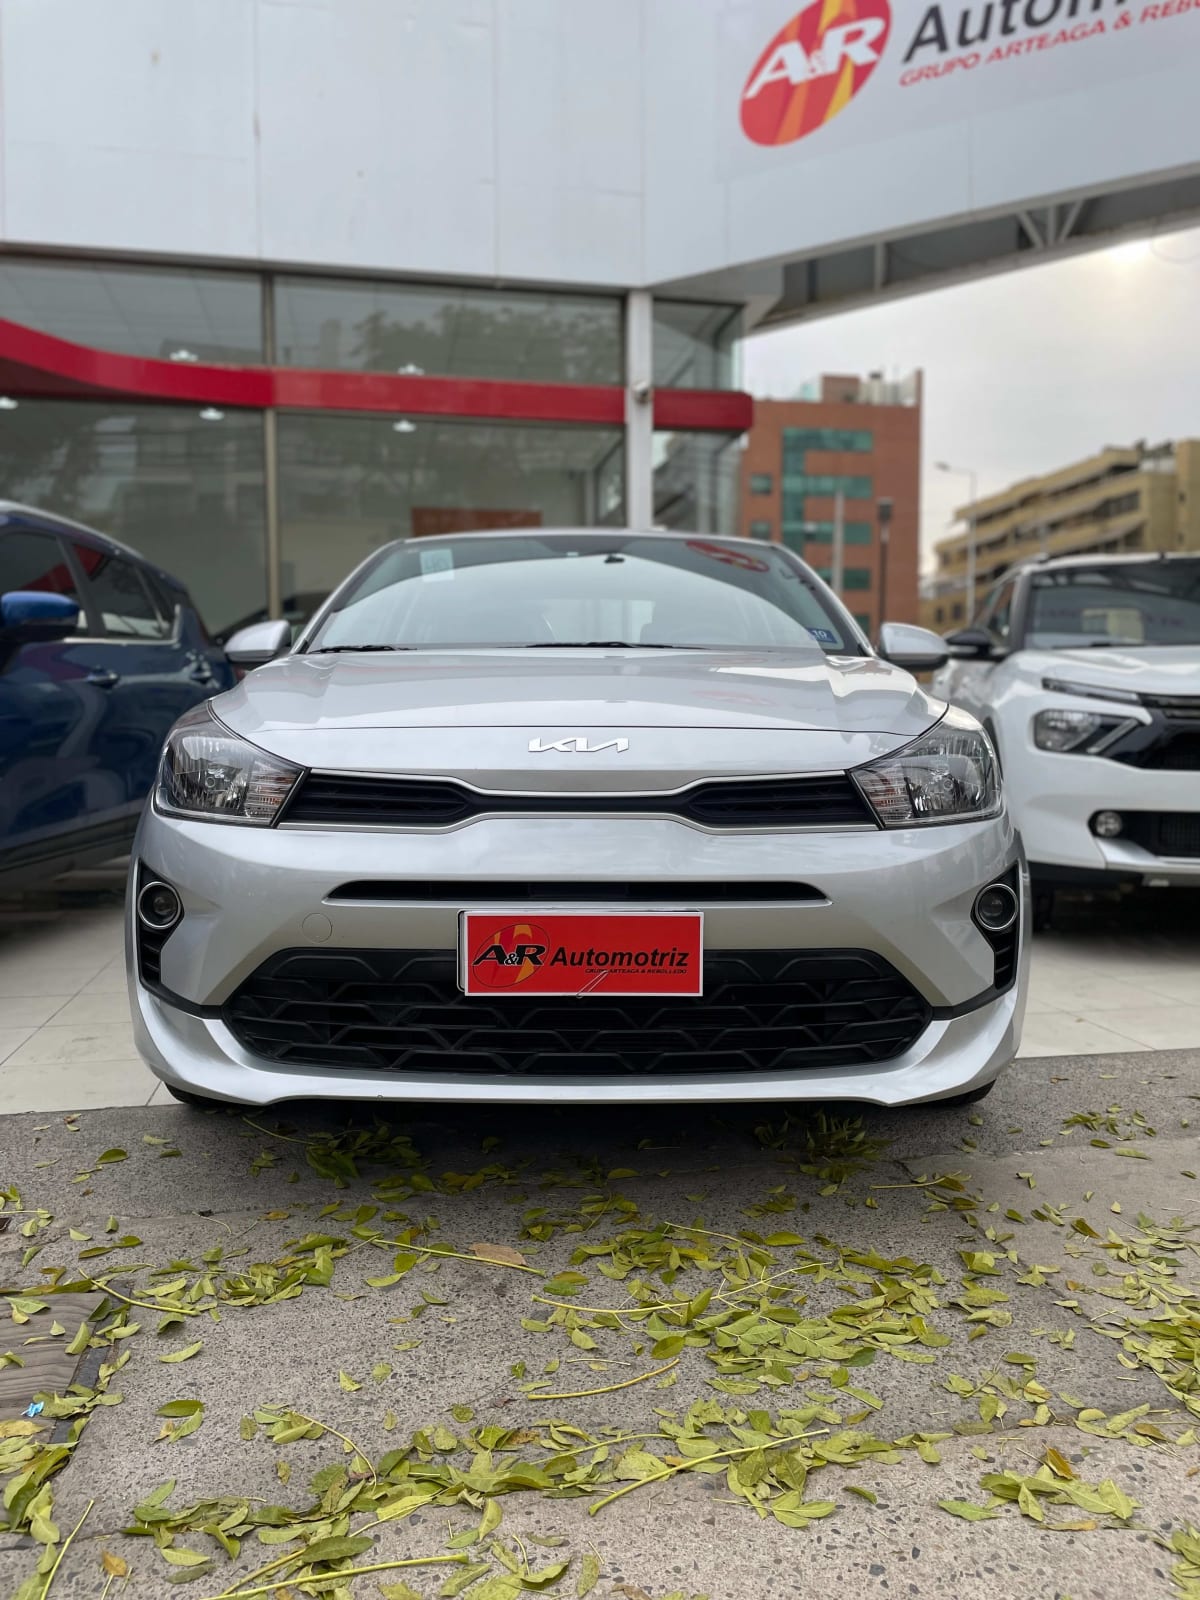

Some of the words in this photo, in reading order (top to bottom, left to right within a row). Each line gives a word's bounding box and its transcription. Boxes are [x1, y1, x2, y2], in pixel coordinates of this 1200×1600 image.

[744, 17, 886, 99] A&R
[900, 53, 981, 87] GRUPO
[985, 19, 1106, 62] ARTEAGA
[1113, 10, 1132, 30] &
[528, 737, 629, 753] KIA
[472, 944, 548, 966] A&R
[550, 947, 690, 967] Automotriz
